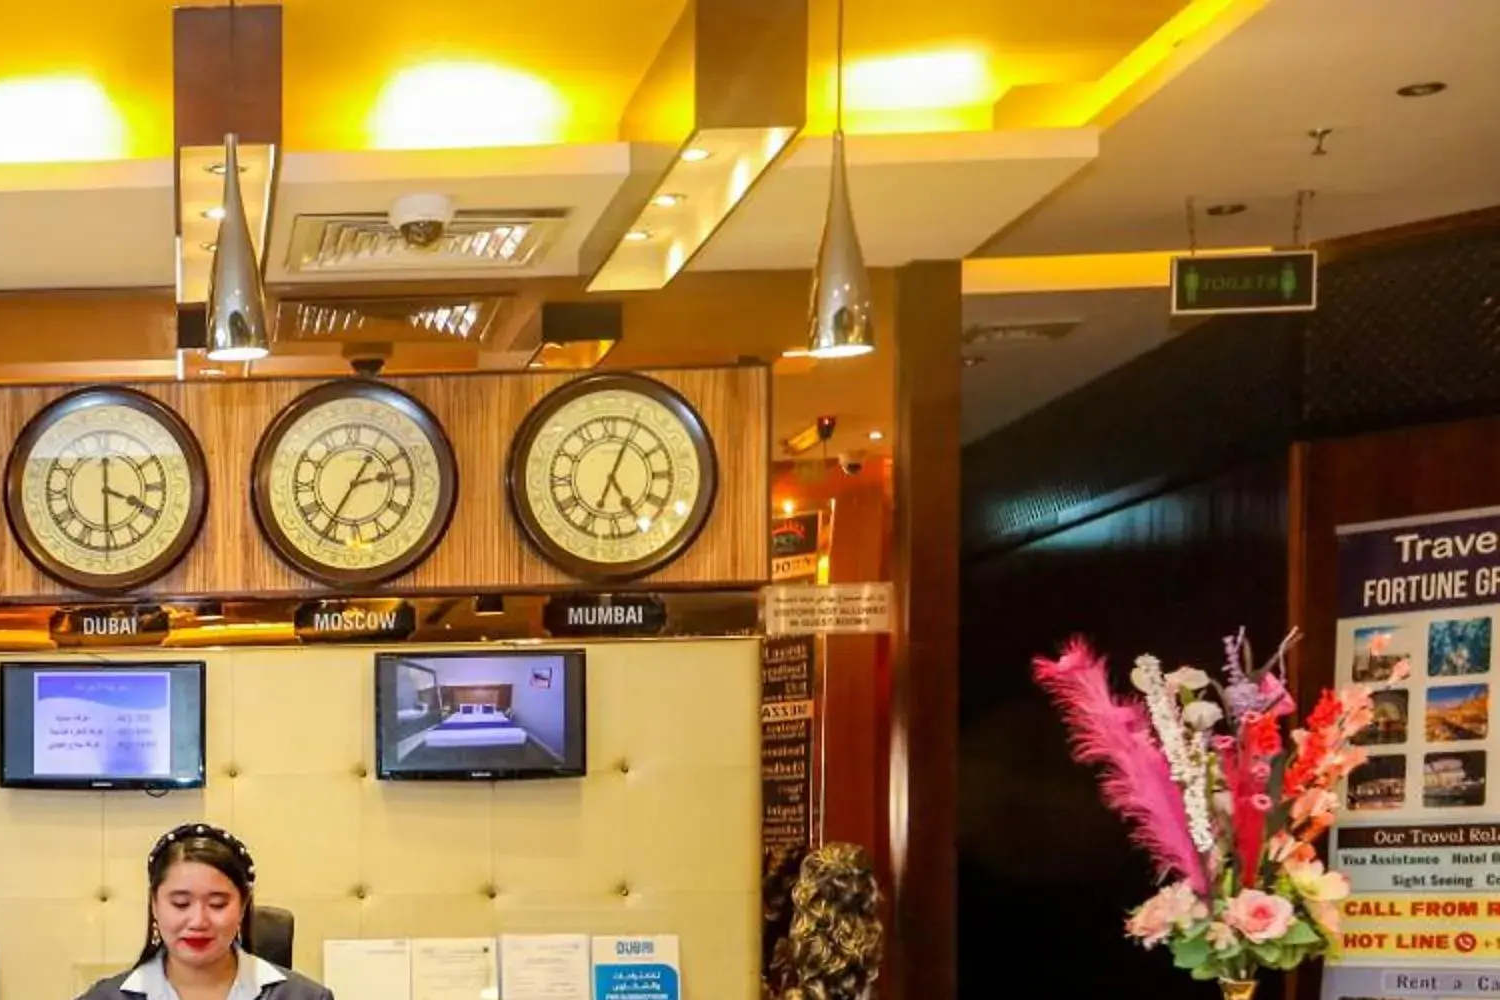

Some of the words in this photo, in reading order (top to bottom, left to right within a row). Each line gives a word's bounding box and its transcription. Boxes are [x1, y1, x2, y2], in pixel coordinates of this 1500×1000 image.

[1394, 531, 1498, 563] Trave
[1363, 569, 1468, 607] FORTUNE
[314, 611, 396, 631] MOSCOW
[568, 605, 644, 625] MUMBAI
[83, 616, 137, 635] DUBAI
[1374, 830, 1404, 844] Our
[1409, 828, 1463, 844] Travel
[1342, 854, 1366, 865] Visa
[1370, 854, 1440, 865] Assistance
[1452, 853, 1486, 864] Hotel
[1392, 875, 1426, 888] Sight
[1430, 874, 1473, 888] Seeing
[1344, 901, 1402, 917] CALL
[1410, 901, 1478, 917] FROM
[1343, 933, 1388, 949] HOT
[1396, 933, 1449, 949] LINE
[1397, 975, 1437, 989] Rent
